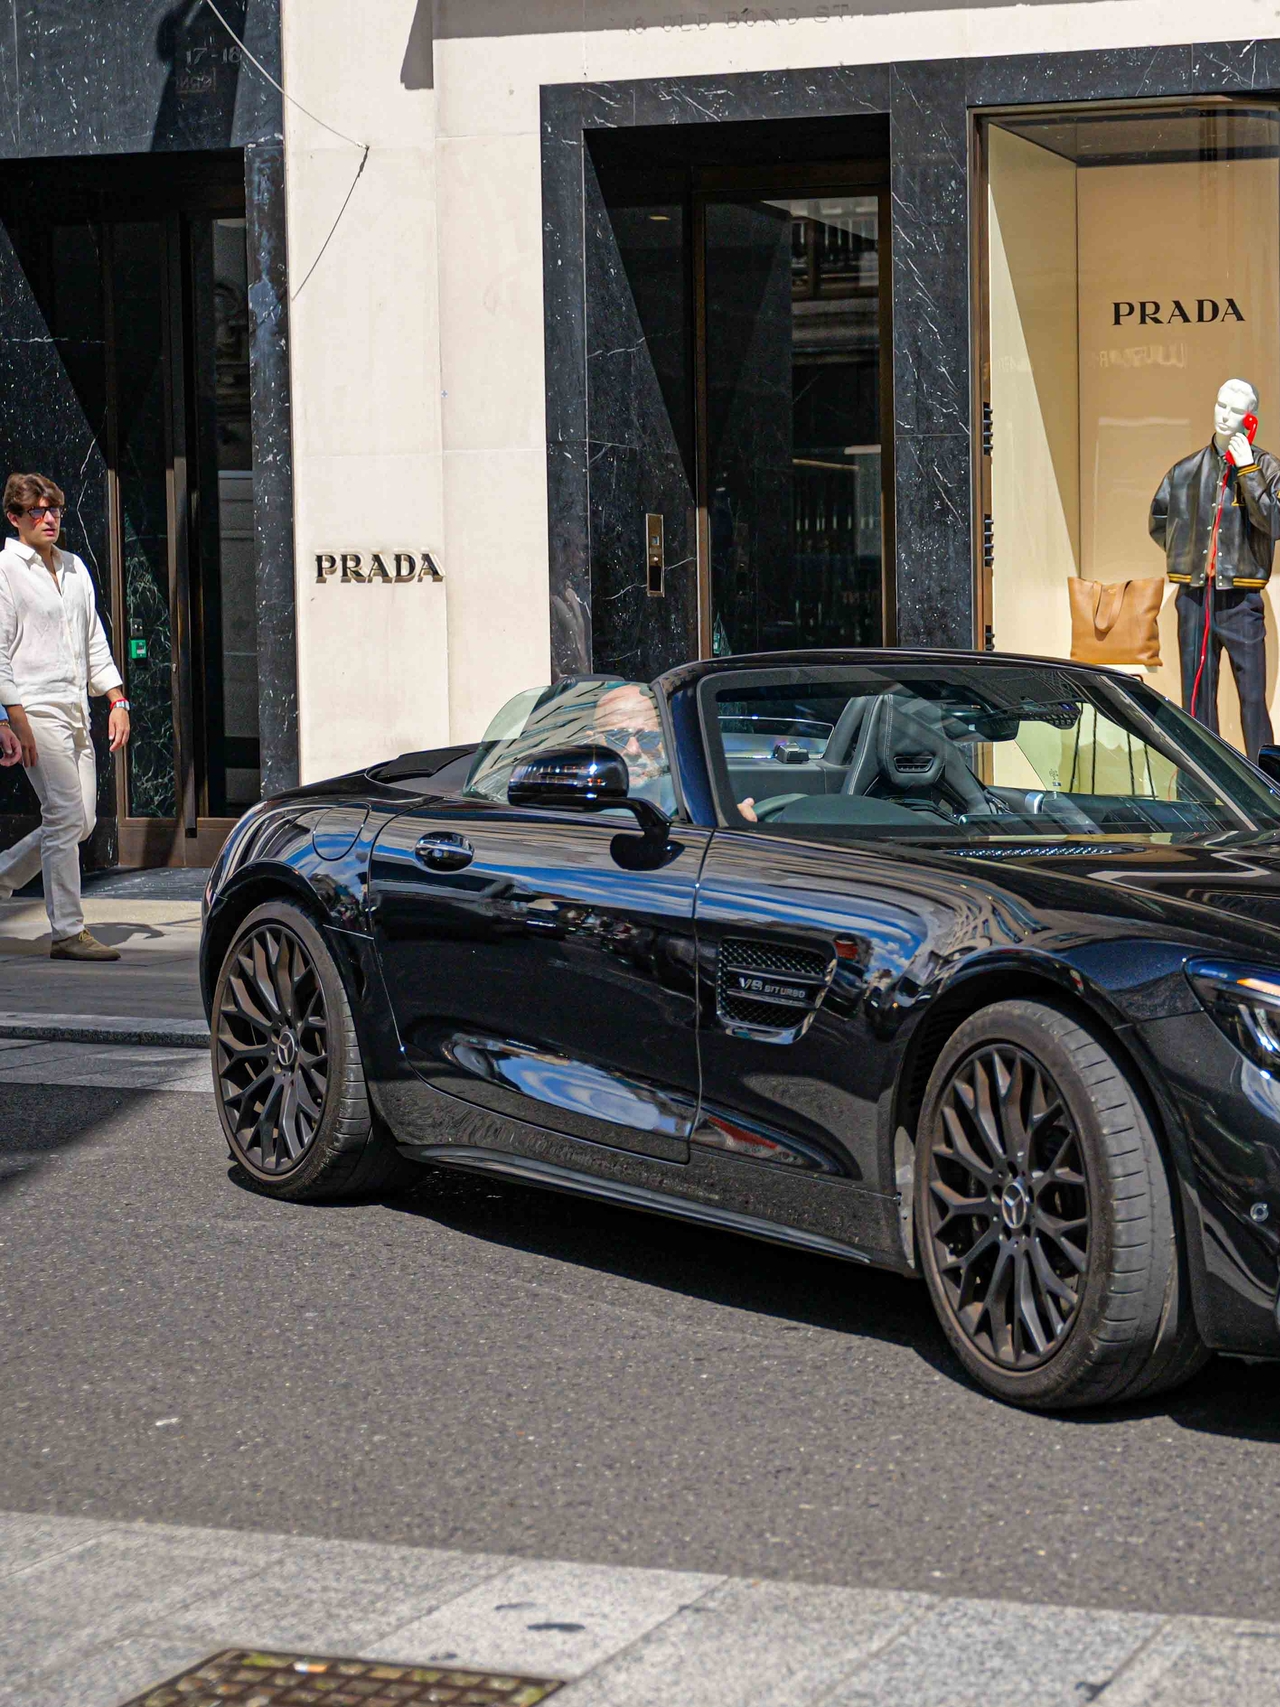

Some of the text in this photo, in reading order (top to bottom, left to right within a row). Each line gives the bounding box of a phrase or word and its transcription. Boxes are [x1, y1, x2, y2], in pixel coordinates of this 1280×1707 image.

[723, 7, 799, 28] BOND
[1111, 298, 1246, 326] PRADA
[314, 552, 444, 583] PRADA
[739, 977, 763, 991] V8
